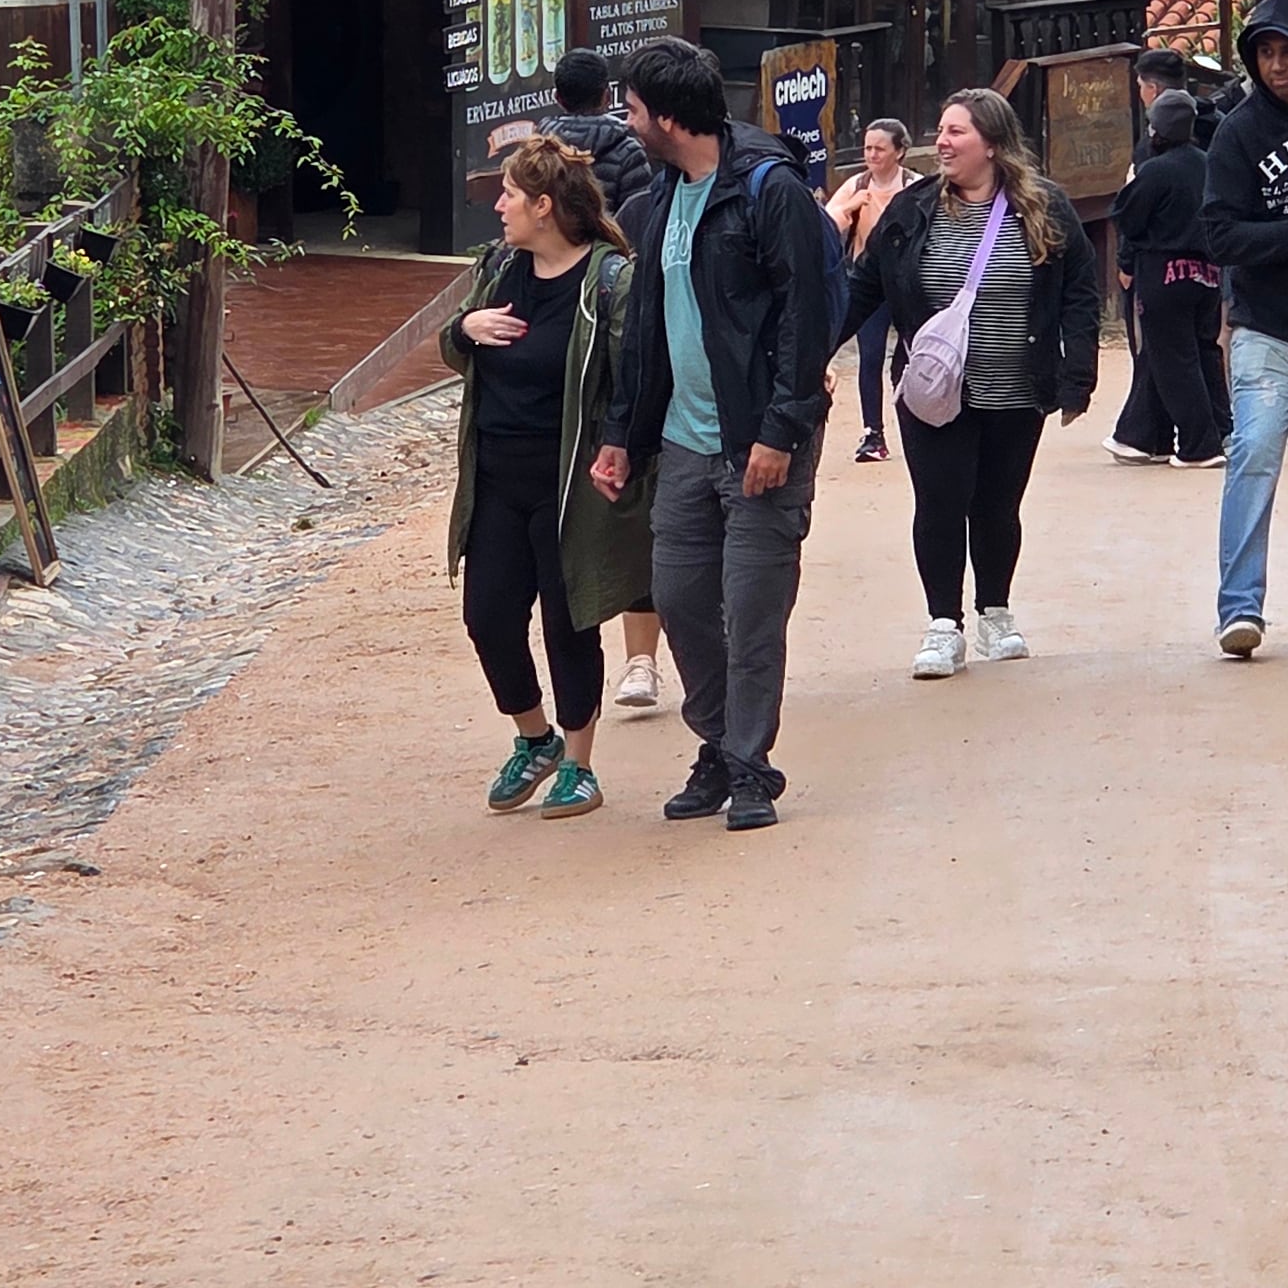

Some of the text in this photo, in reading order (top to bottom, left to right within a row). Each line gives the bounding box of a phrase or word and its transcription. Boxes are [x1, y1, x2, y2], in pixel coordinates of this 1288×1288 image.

[589, 3, 620, 21] TABLA
[621, 1, 634, 16] DE
[448, 27, 478, 49] BEBIDAS
[600, 21, 635, 39] PLATOS
[775, 66, 826, 107] crelech
